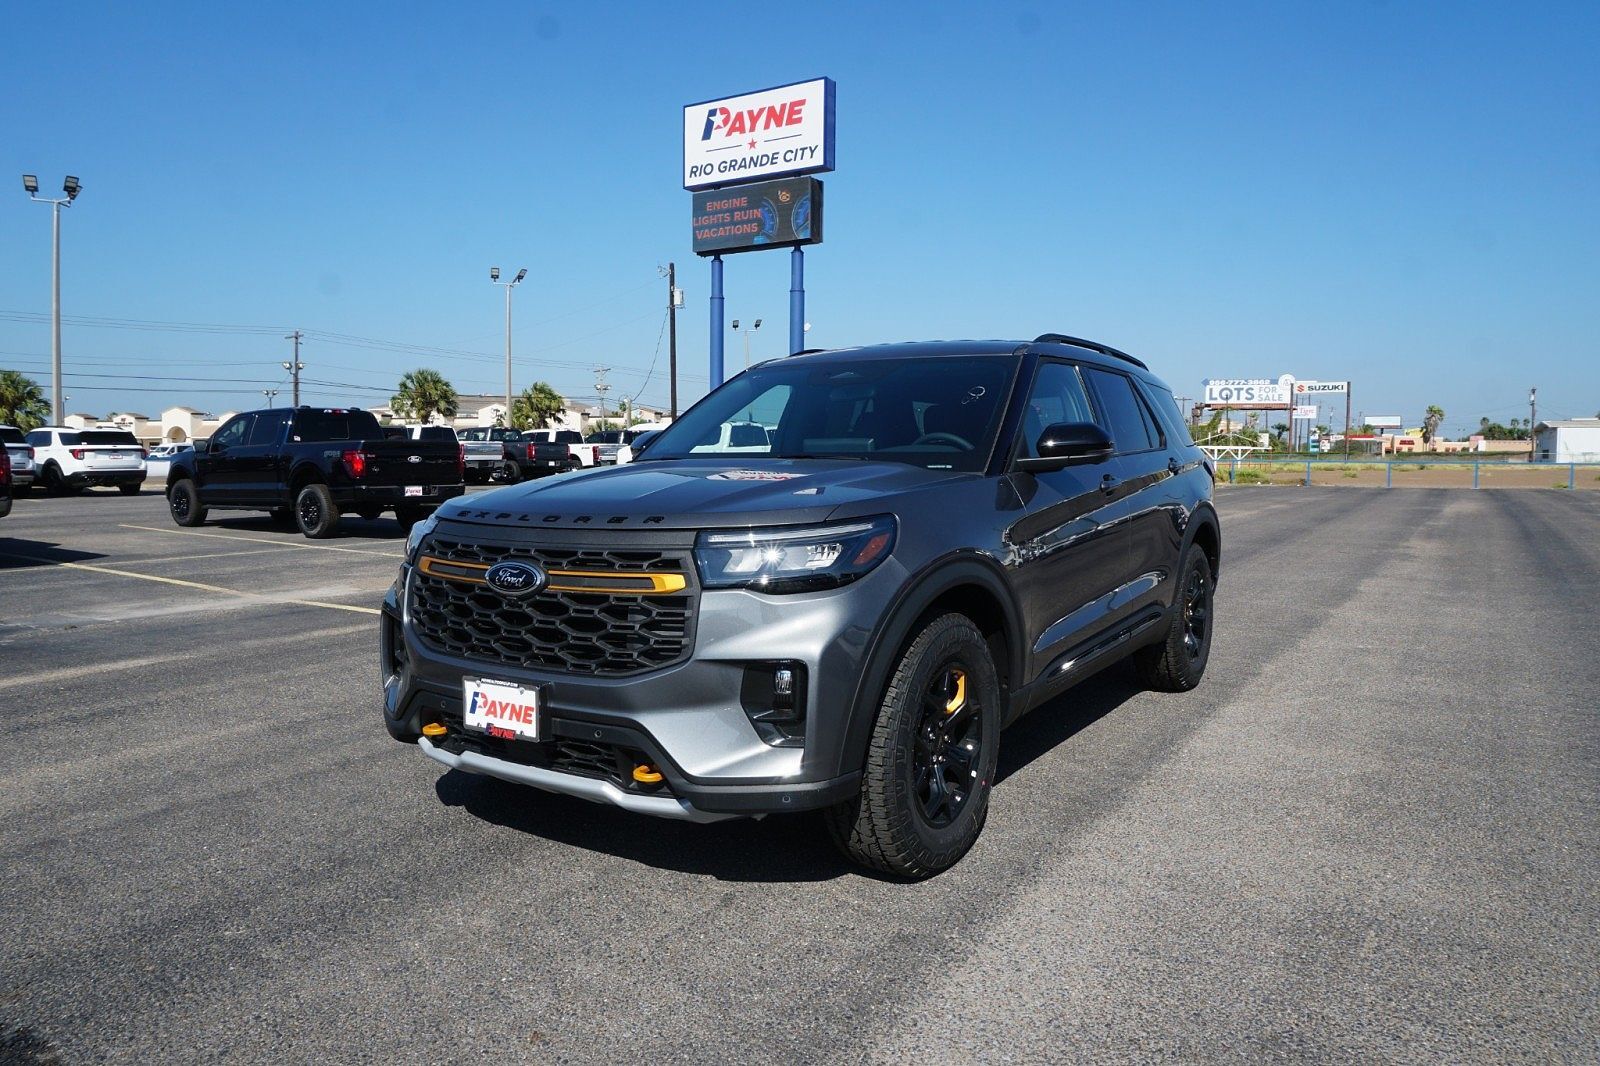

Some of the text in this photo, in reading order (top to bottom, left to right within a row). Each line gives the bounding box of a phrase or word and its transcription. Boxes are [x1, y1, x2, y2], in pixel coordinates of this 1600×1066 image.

[702, 98, 806, 141] PAYNE
[689, 144, 819, 179] RIO GRANDE CITY
[706, 196, 748, 211] ENGINE
[734, 208, 762, 221] RUIN
[696, 223, 758, 239] VACATIONS
[1208, 386, 1278, 401] LOTS FOR
[1257, 393, 1284, 402] SALE
[457, 510, 666, 525] EXPLORER
[495, 568, 527, 587] Ford
[469, 691, 534, 724] PAYNE
[486, 722, 515, 739] PAYNE
